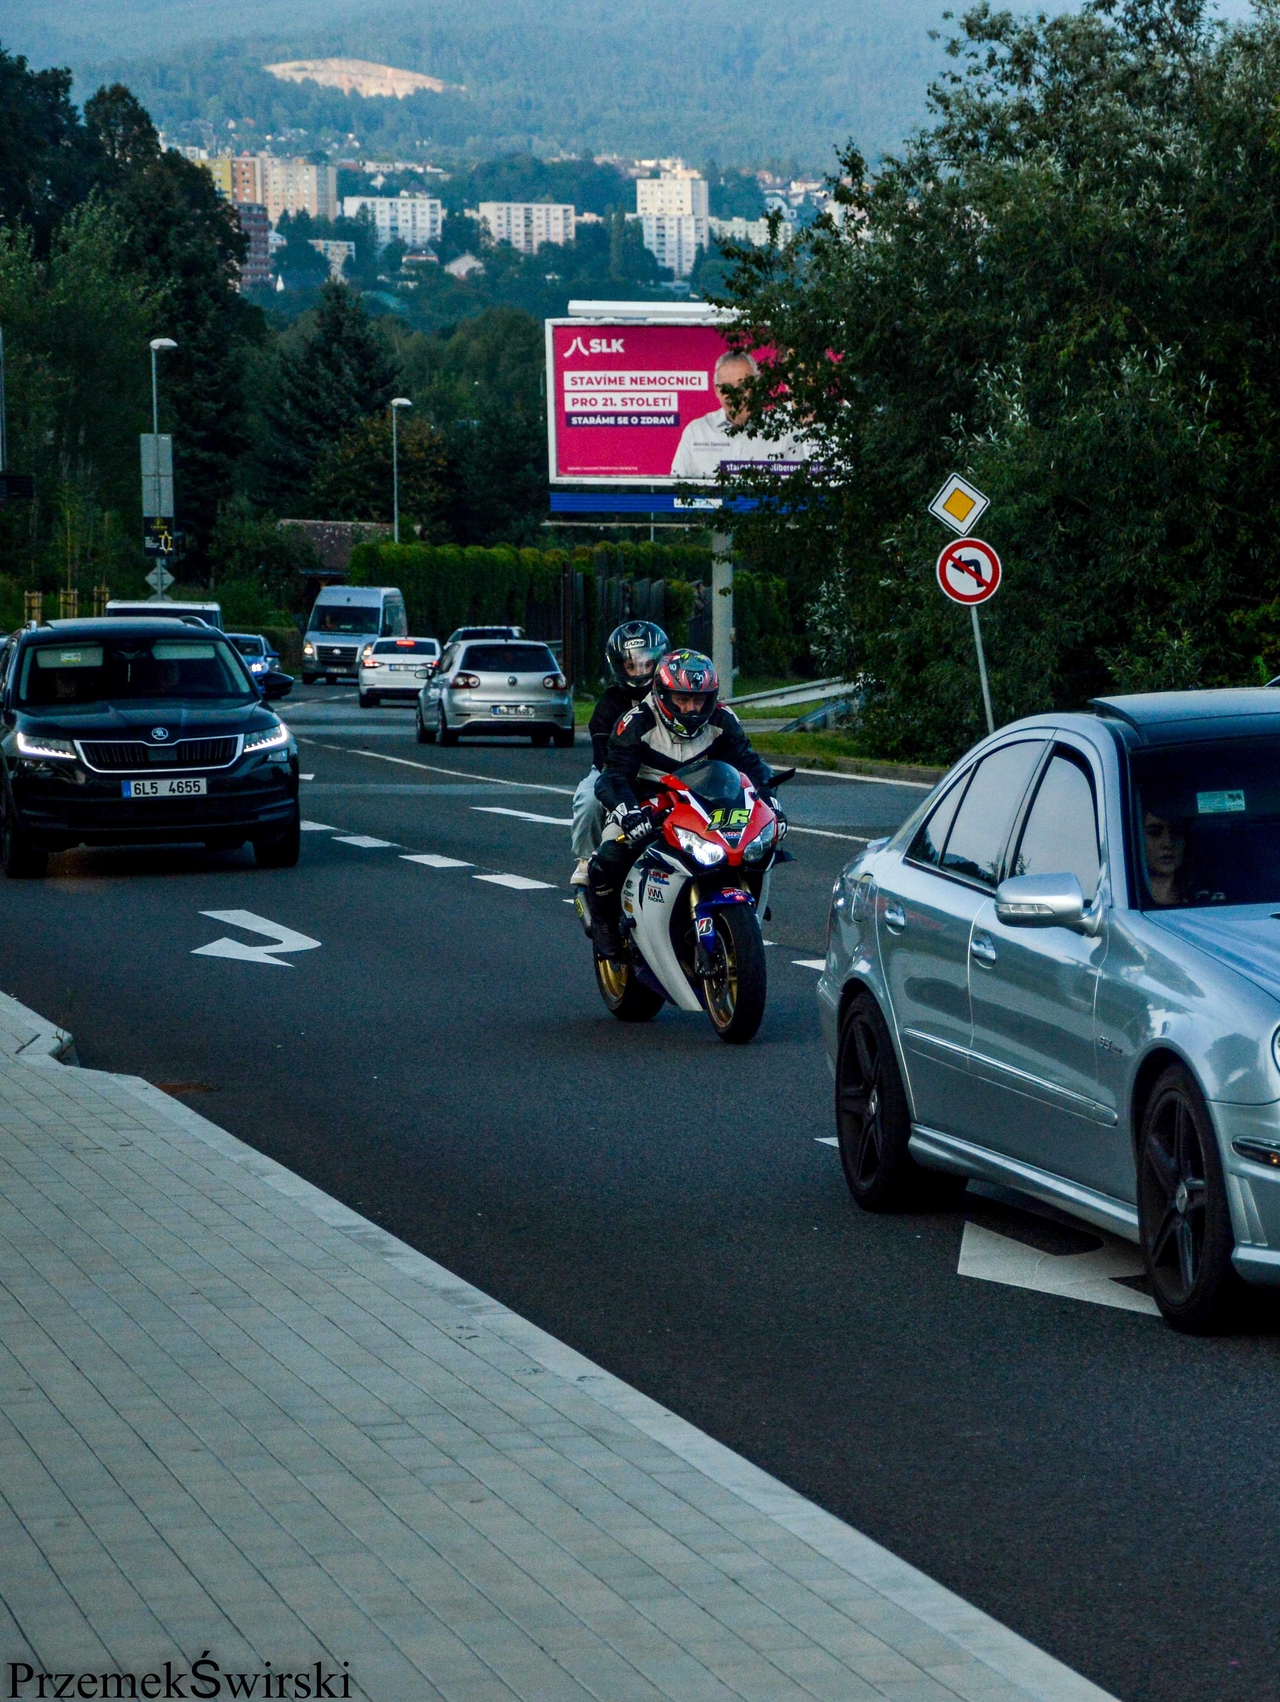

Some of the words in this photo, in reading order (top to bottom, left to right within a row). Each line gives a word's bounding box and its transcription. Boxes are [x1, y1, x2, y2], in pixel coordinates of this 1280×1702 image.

[589, 338, 625, 353] SLK
[571, 374, 626, 386] STAVÍME
[630, 376, 702, 386] NEMOCNICI
[571, 397, 598, 407] PRO
[602, 397, 617, 407] 21.
[621, 395, 672, 407] STOLETÍ
[571, 415, 615, 425] STARÁME
[617, 416, 629, 425] SE
[630, 416, 639, 425] O
[640, 415, 675, 425] ZDRAVÍ
[134, 782, 158, 795] 6L5
[169, 780, 201, 794] 4655
[706, 808, 752, 831] 16
